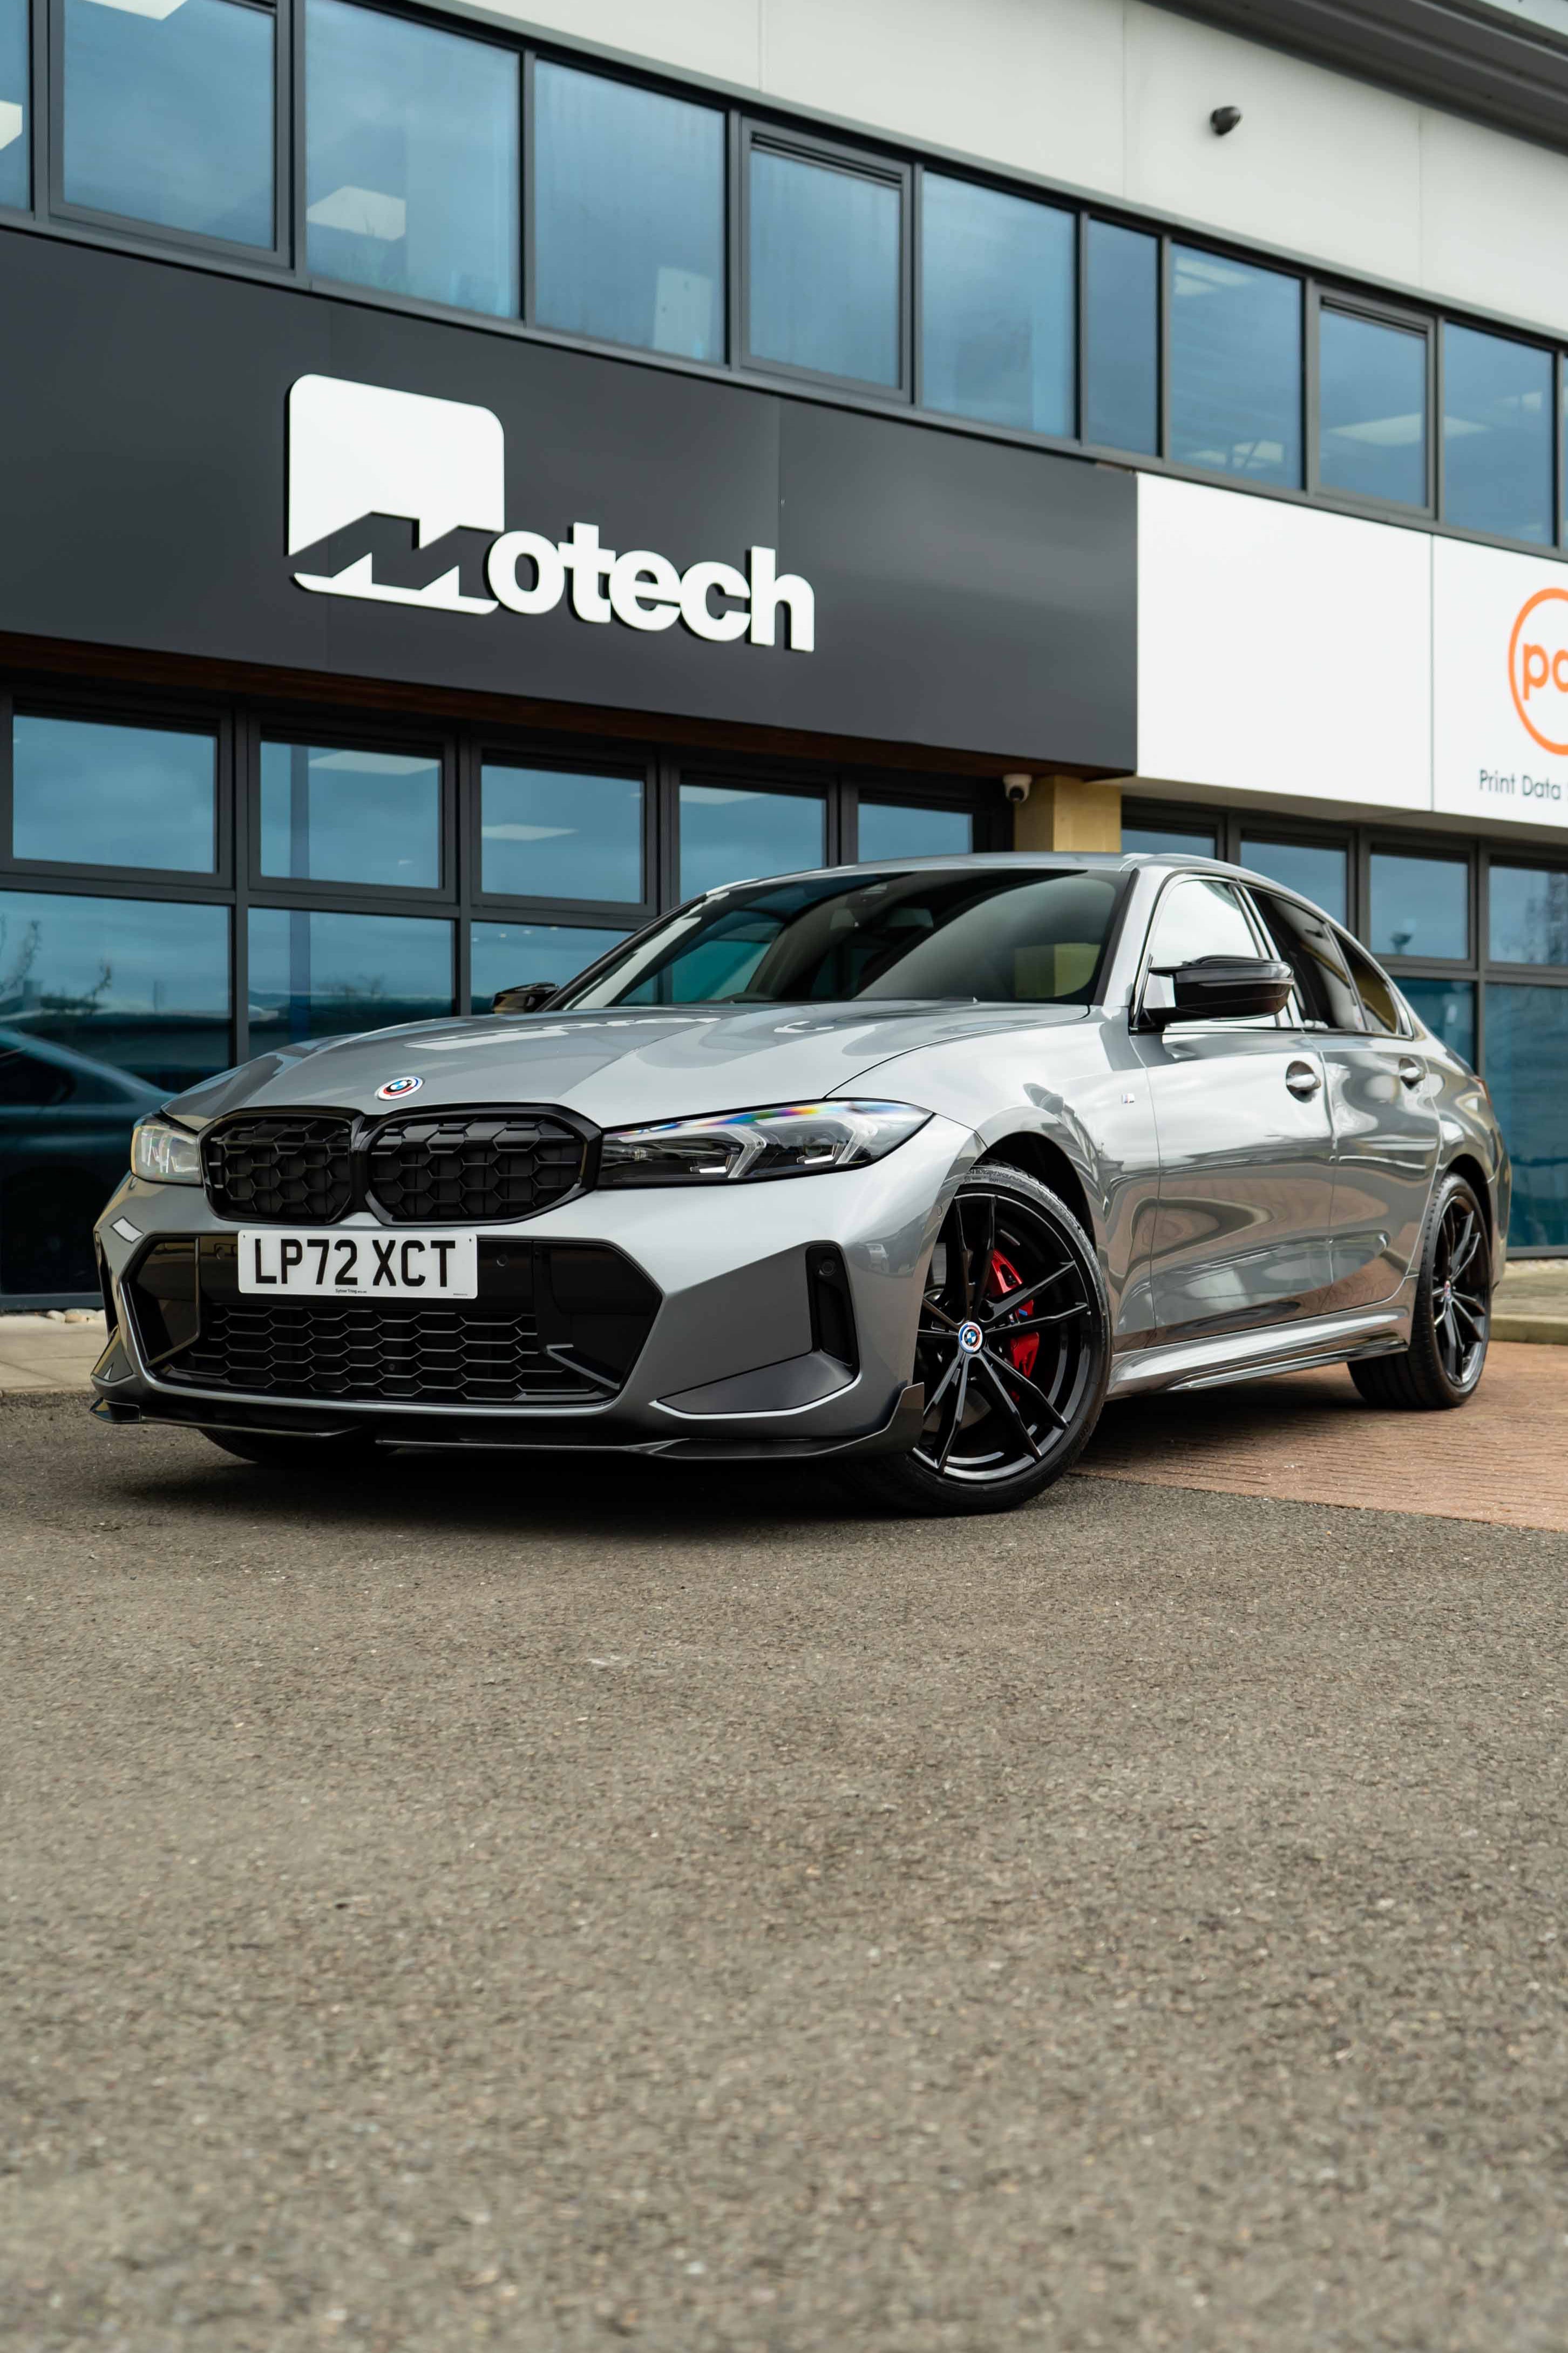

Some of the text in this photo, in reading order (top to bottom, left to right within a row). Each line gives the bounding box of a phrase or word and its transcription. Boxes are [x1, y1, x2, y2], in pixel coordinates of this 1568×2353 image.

[1479, 769, 1516, 795] Print
[1522, 774, 1561, 801] Data
[255, 1238, 456, 1287] LP72 XCT
